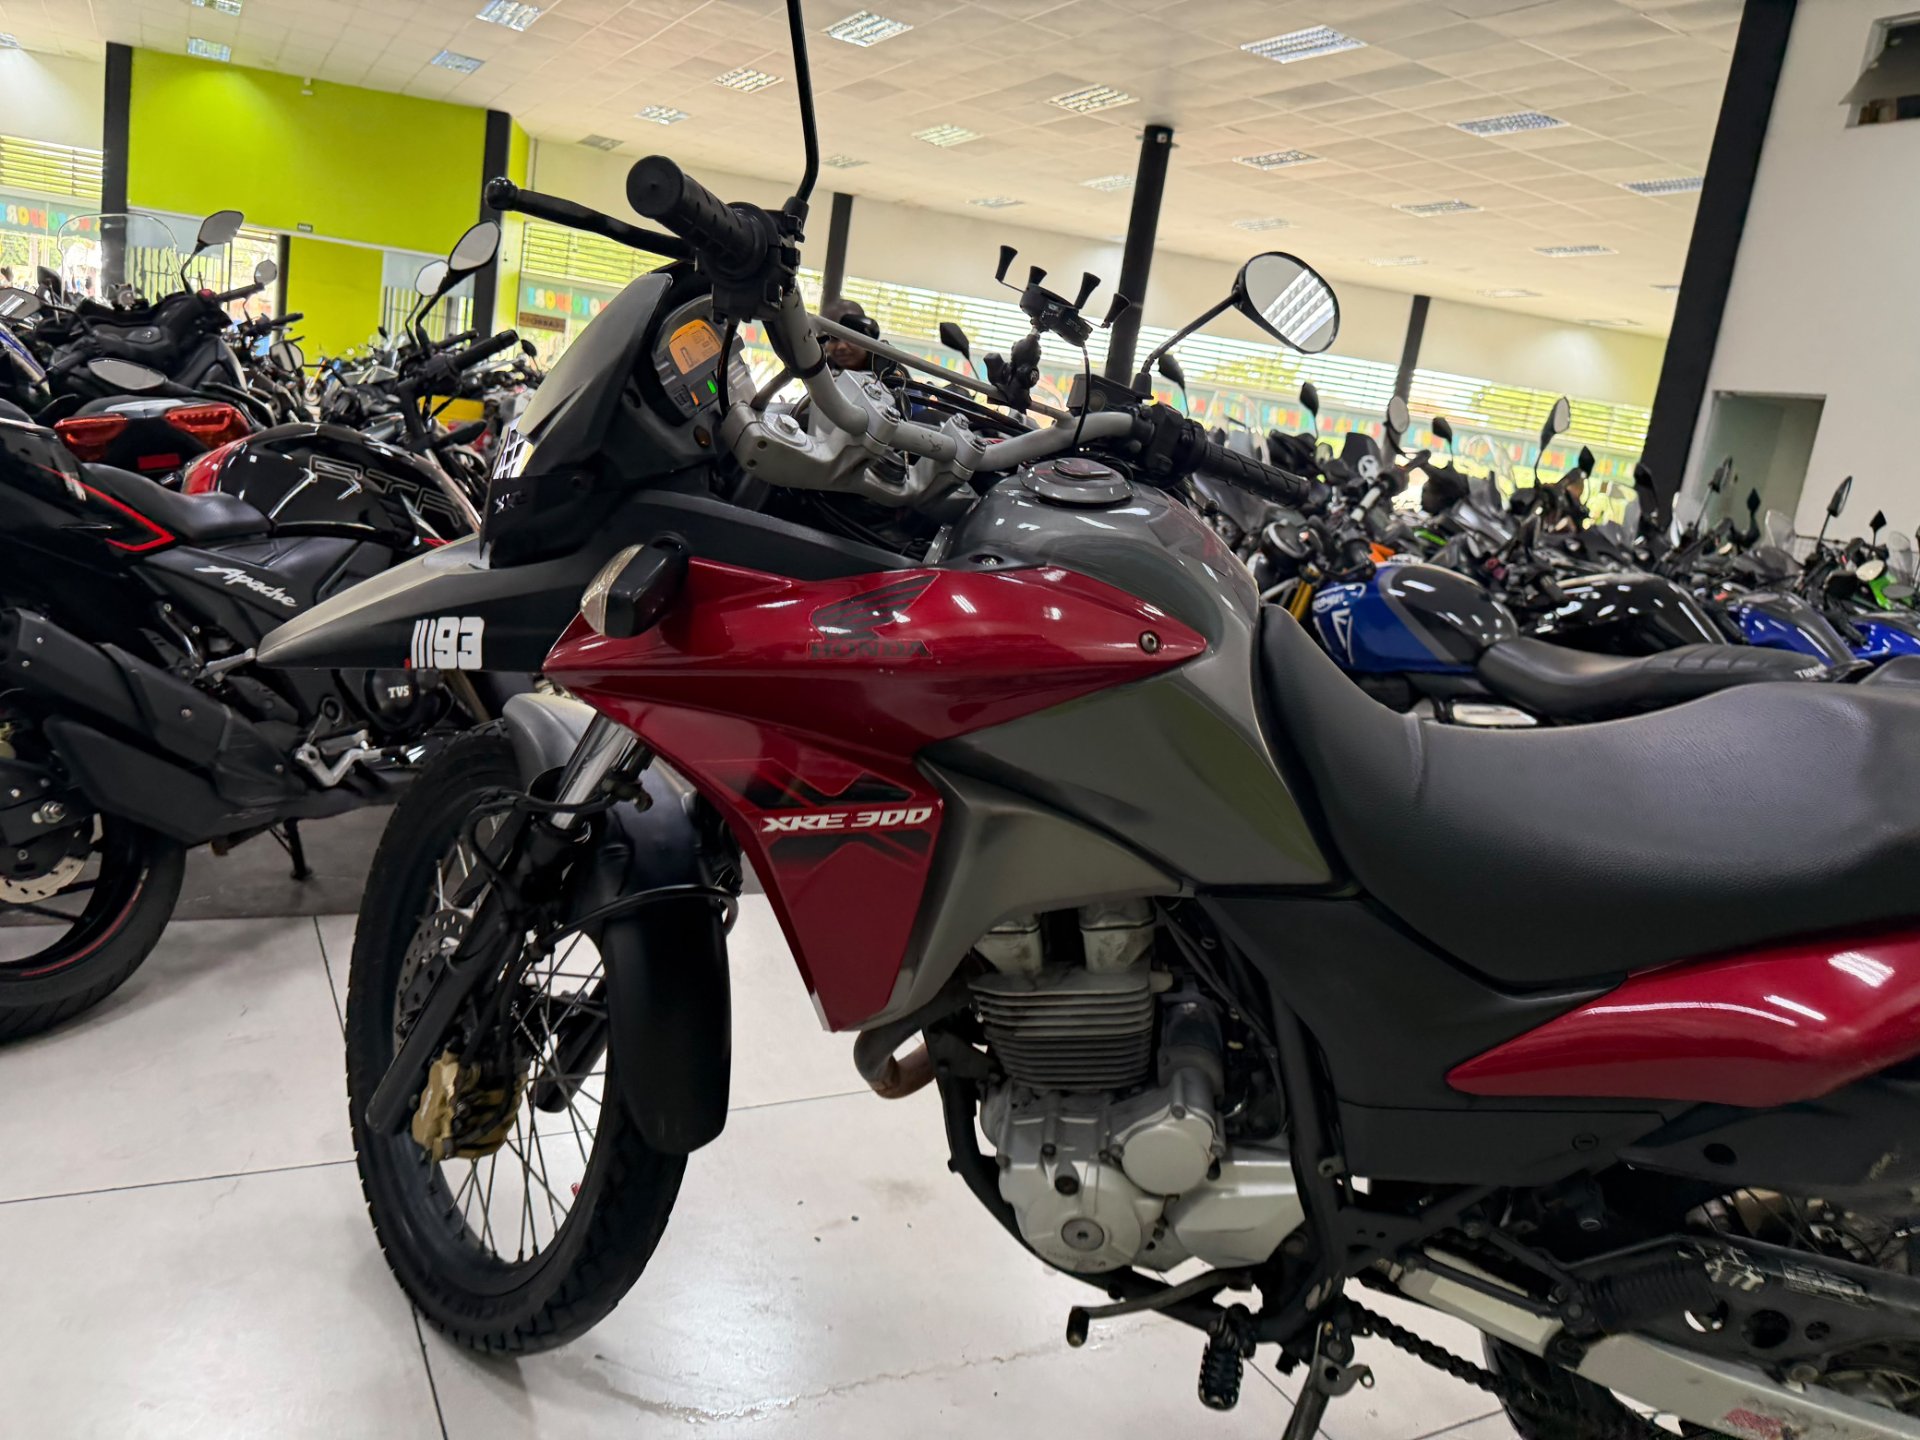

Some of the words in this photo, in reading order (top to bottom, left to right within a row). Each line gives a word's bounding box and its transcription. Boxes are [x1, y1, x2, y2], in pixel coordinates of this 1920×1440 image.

[194, 565, 298, 607] Apache
[810, 640, 930, 658] HONDA
[387, 685, 410, 699] TVS
[761, 813, 849, 833] XRE
[851, 807, 933, 828] 300
